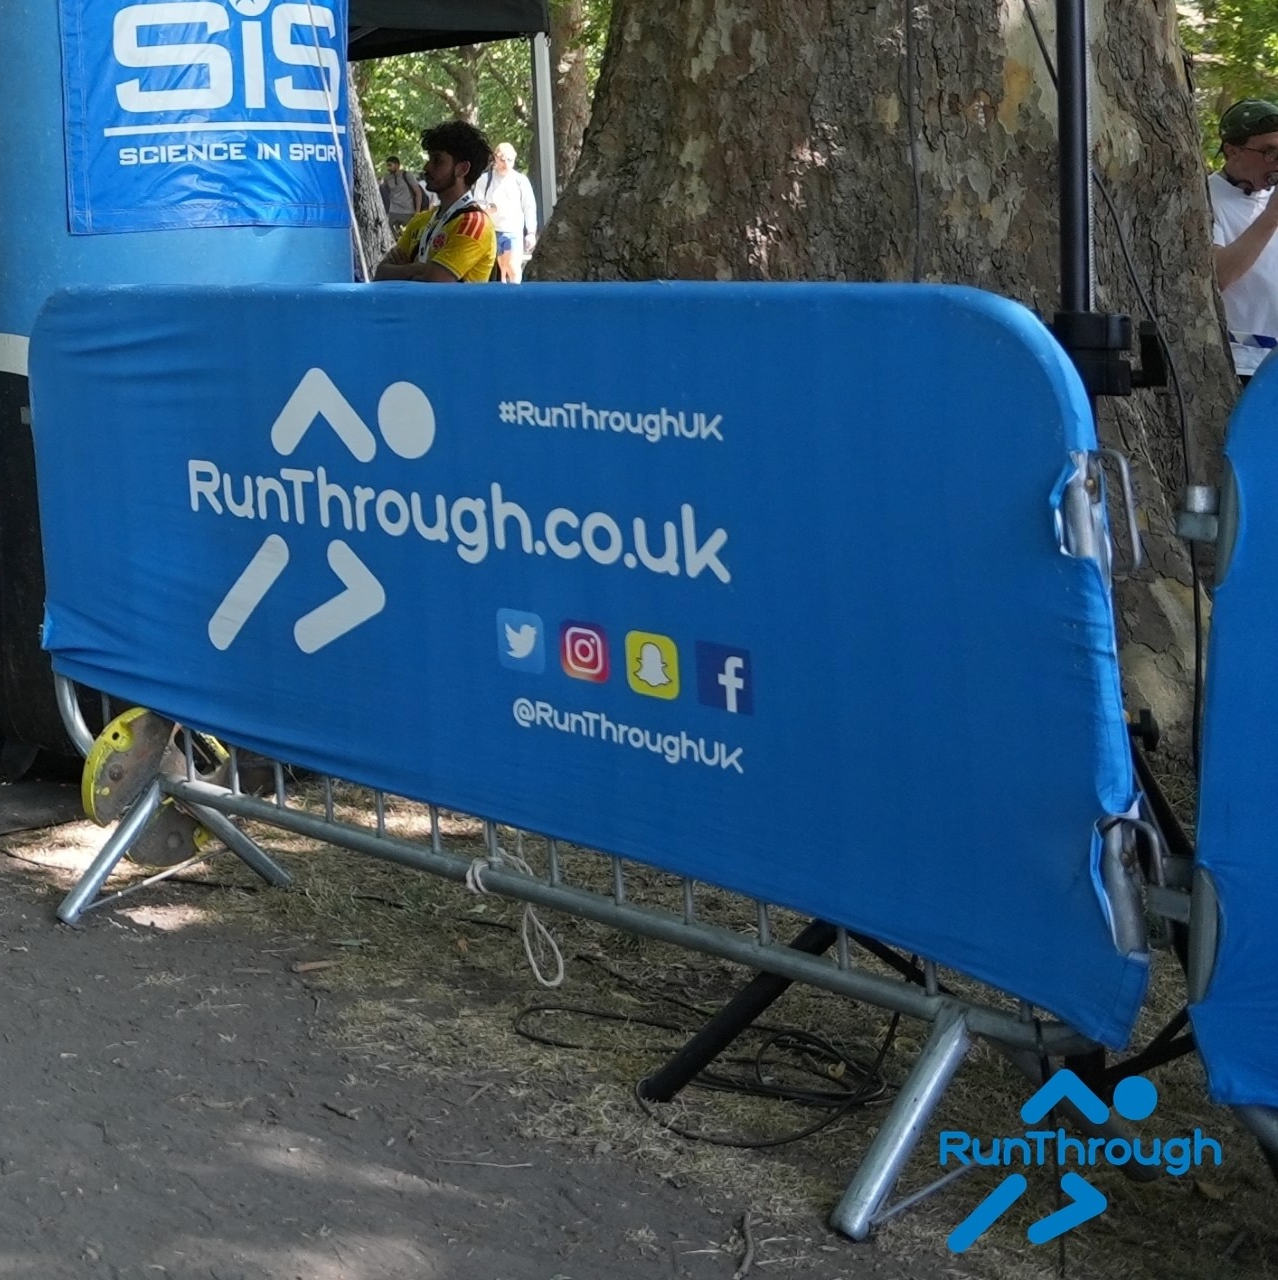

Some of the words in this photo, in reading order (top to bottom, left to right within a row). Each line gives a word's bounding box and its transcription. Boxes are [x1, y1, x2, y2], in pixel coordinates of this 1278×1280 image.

[119, 142, 247, 166] SCIENCE
[256, 142, 282, 161] IN
[498, 399, 724, 442] #RunThroughUK
[187, 458, 732, 583] RunThrough.co.uk
[511, 696, 744, 774] @RunThroughUK
